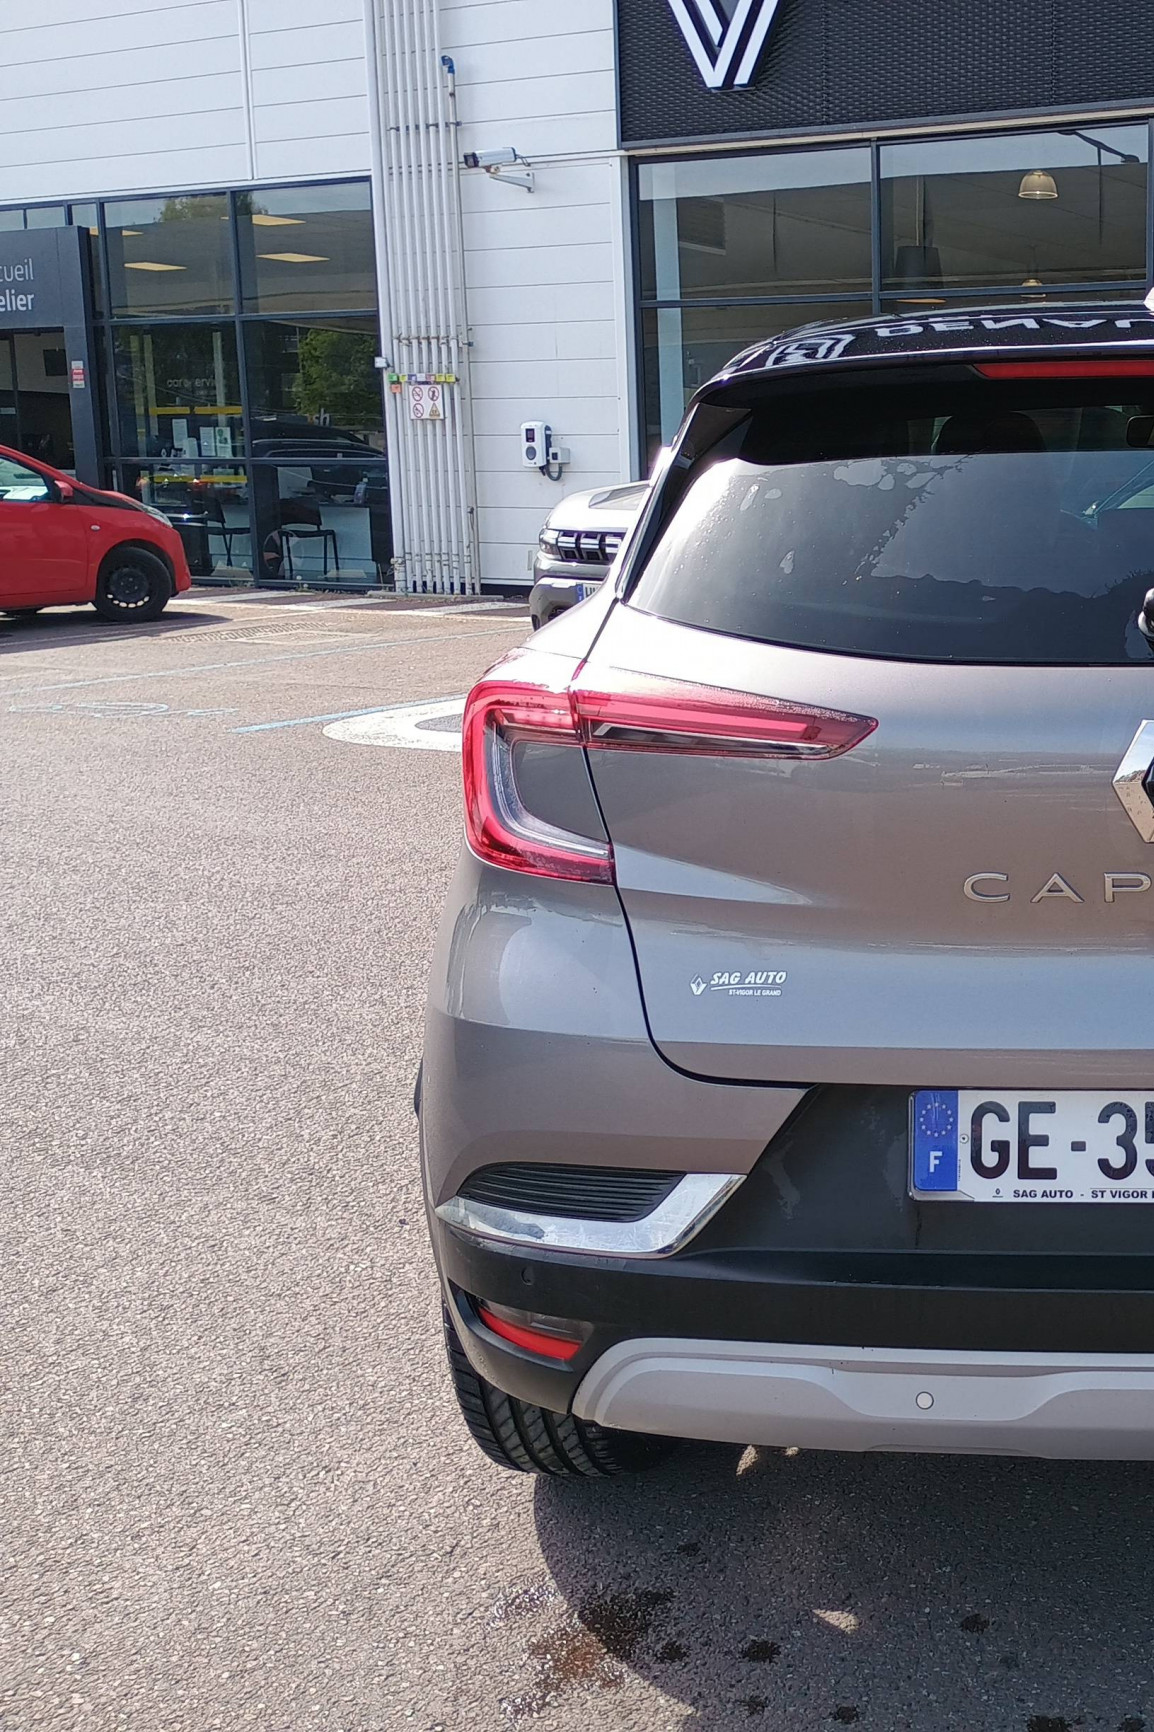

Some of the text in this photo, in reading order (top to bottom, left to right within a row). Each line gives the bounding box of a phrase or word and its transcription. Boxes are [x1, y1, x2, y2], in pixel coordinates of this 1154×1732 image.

[710, 971, 787, 984] SAG AUTO
[928, 1151, 943, 1173] F
[1013, 1189, 1038, 1199] SAG
[1040, 1189, 1074, 1199] AUTO
[1091, 1189, 1107, 1199] ST
[1109, 1189, 1148, 1199] VIGOR
